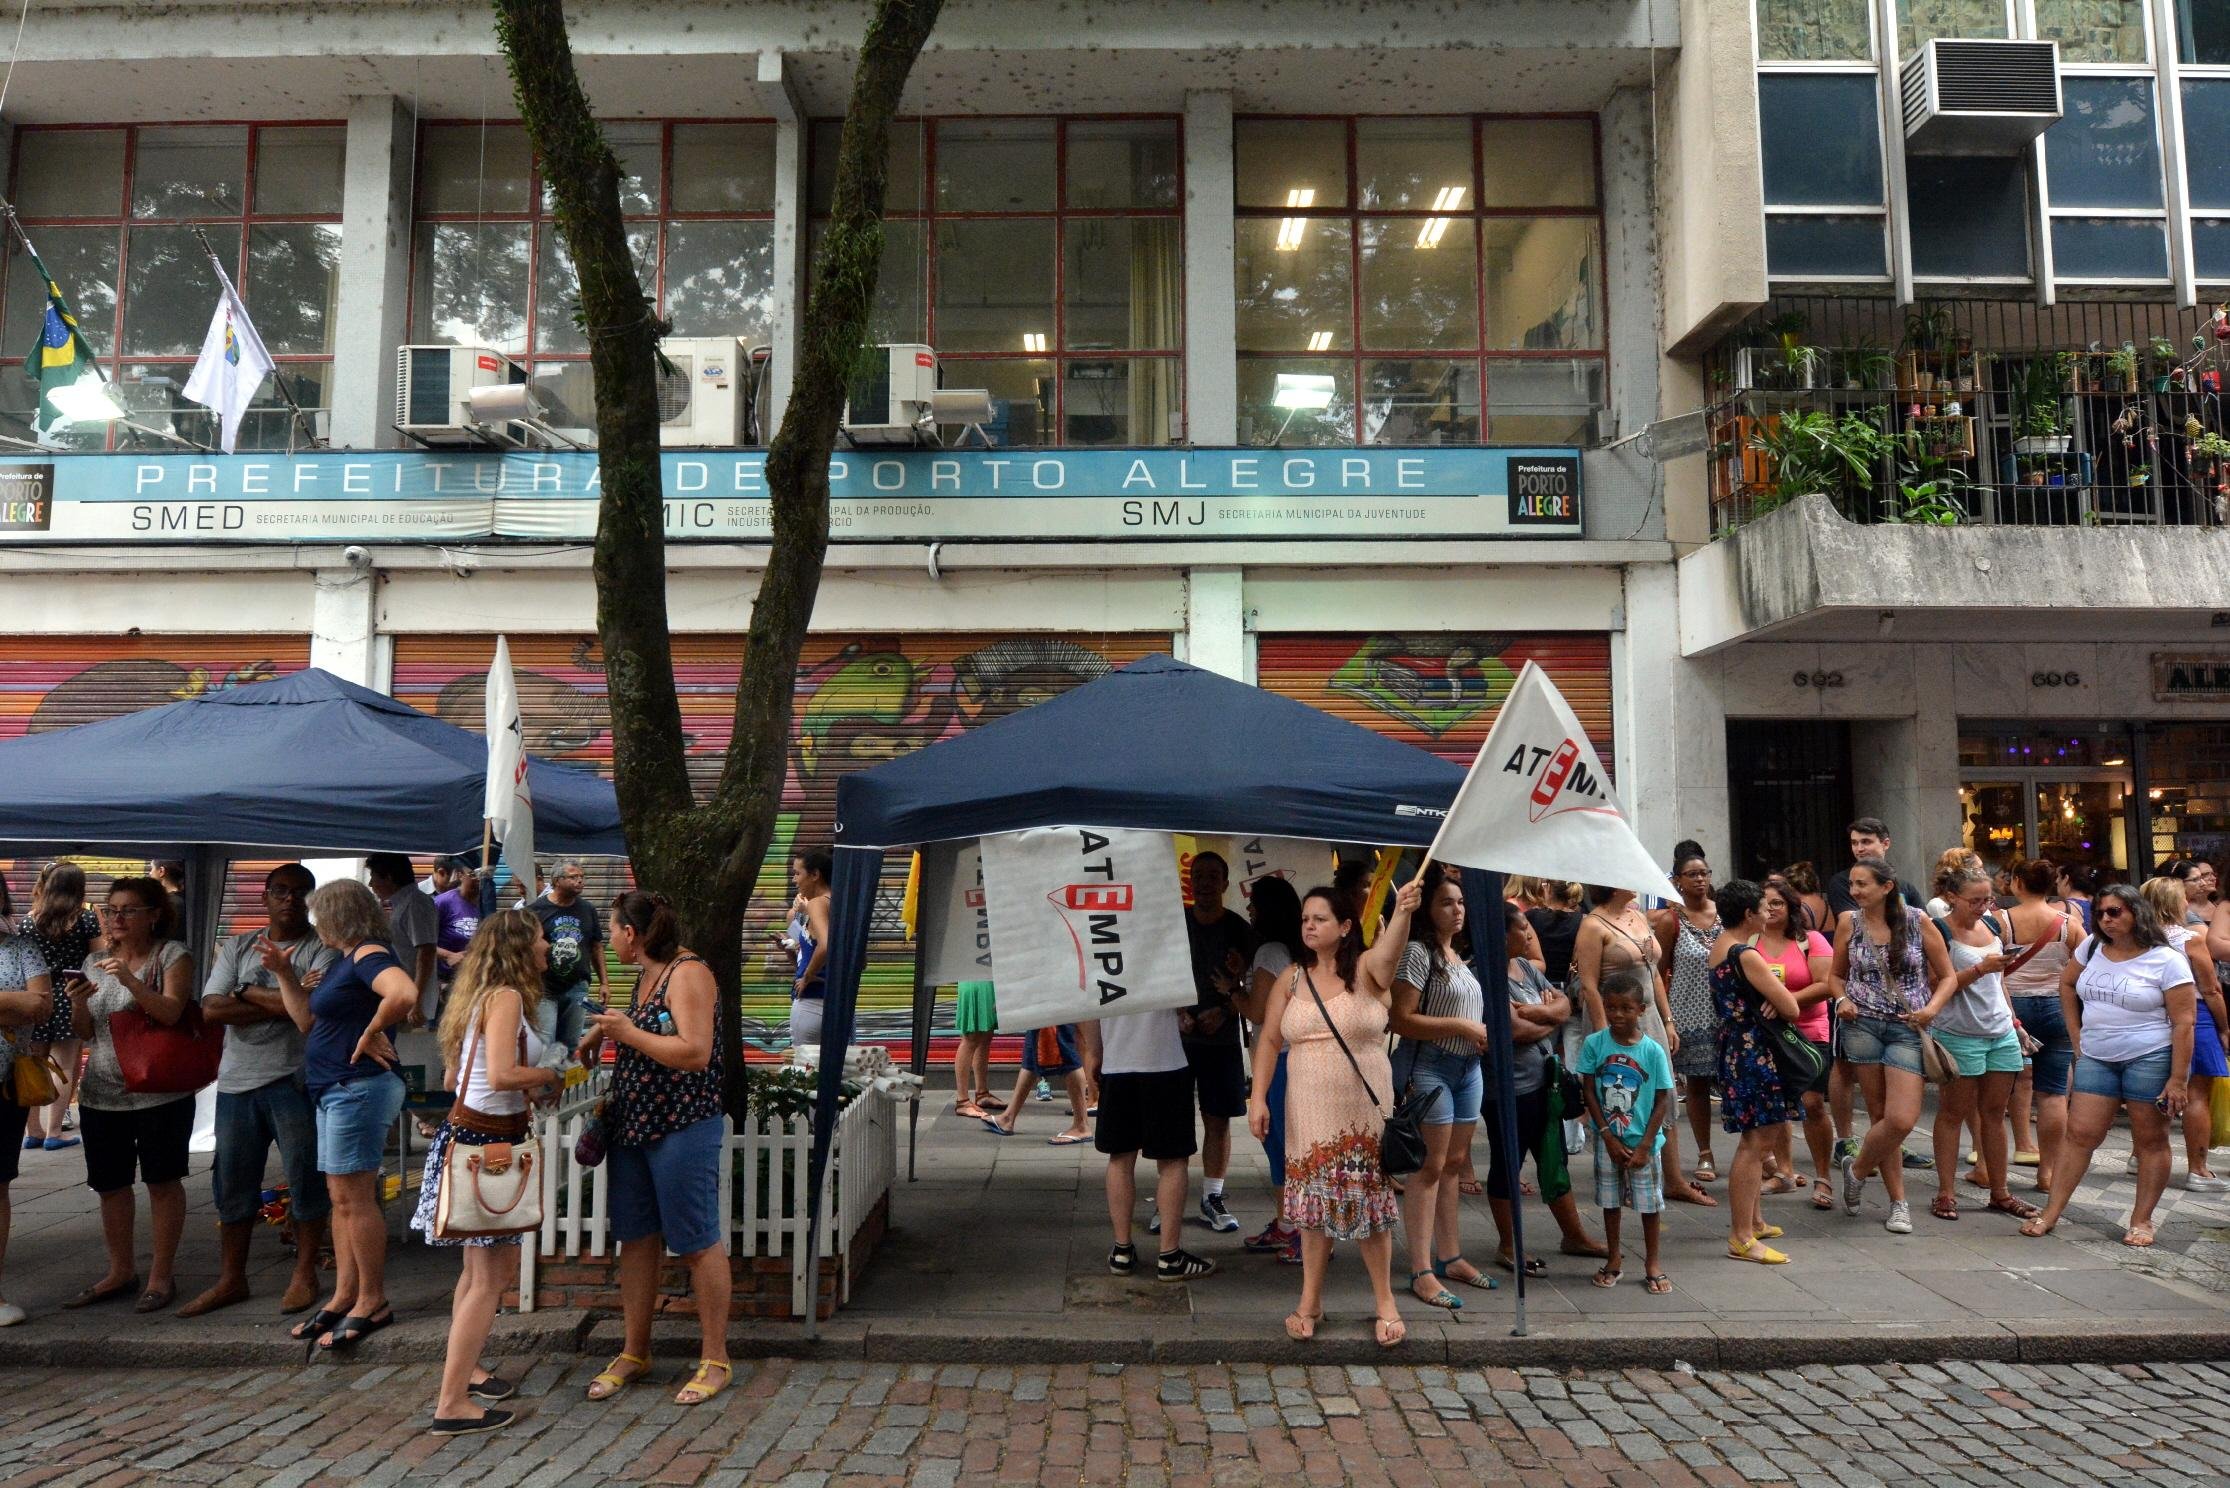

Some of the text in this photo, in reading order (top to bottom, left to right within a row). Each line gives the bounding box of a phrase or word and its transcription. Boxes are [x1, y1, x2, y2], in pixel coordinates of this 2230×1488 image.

[34, 472, 44, 480] de
[676, 461, 761, 491] DE
[1122, 458, 1426, 488] ALEGRE
[1518, 465, 1567, 473] Prefeitura de
[1518, 474, 1567, 495] PORTO
[0, 502, 44, 523] LEGRE
[663, 503, 714, 527] IC
[727, 506, 772, 516] SECRETA
[830, 506, 853, 516] IPAL
[856, 506, 870, 516] DA
[1122, 501, 1426, 526] SMJ SECRETARIA MUNICIPAL DA JUVENTUDE
[1517, 495, 1570, 517] ALEGRE
[132, 505, 454, 531] SMED SECRETARIA MUNICIPAL DE EDUCAÇÃO
[727, 518, 772, 527] INDUSTR
[1503, 742, 1606, 801] ATEM
[1076, 829, 1128, 1006] ATEMPA
